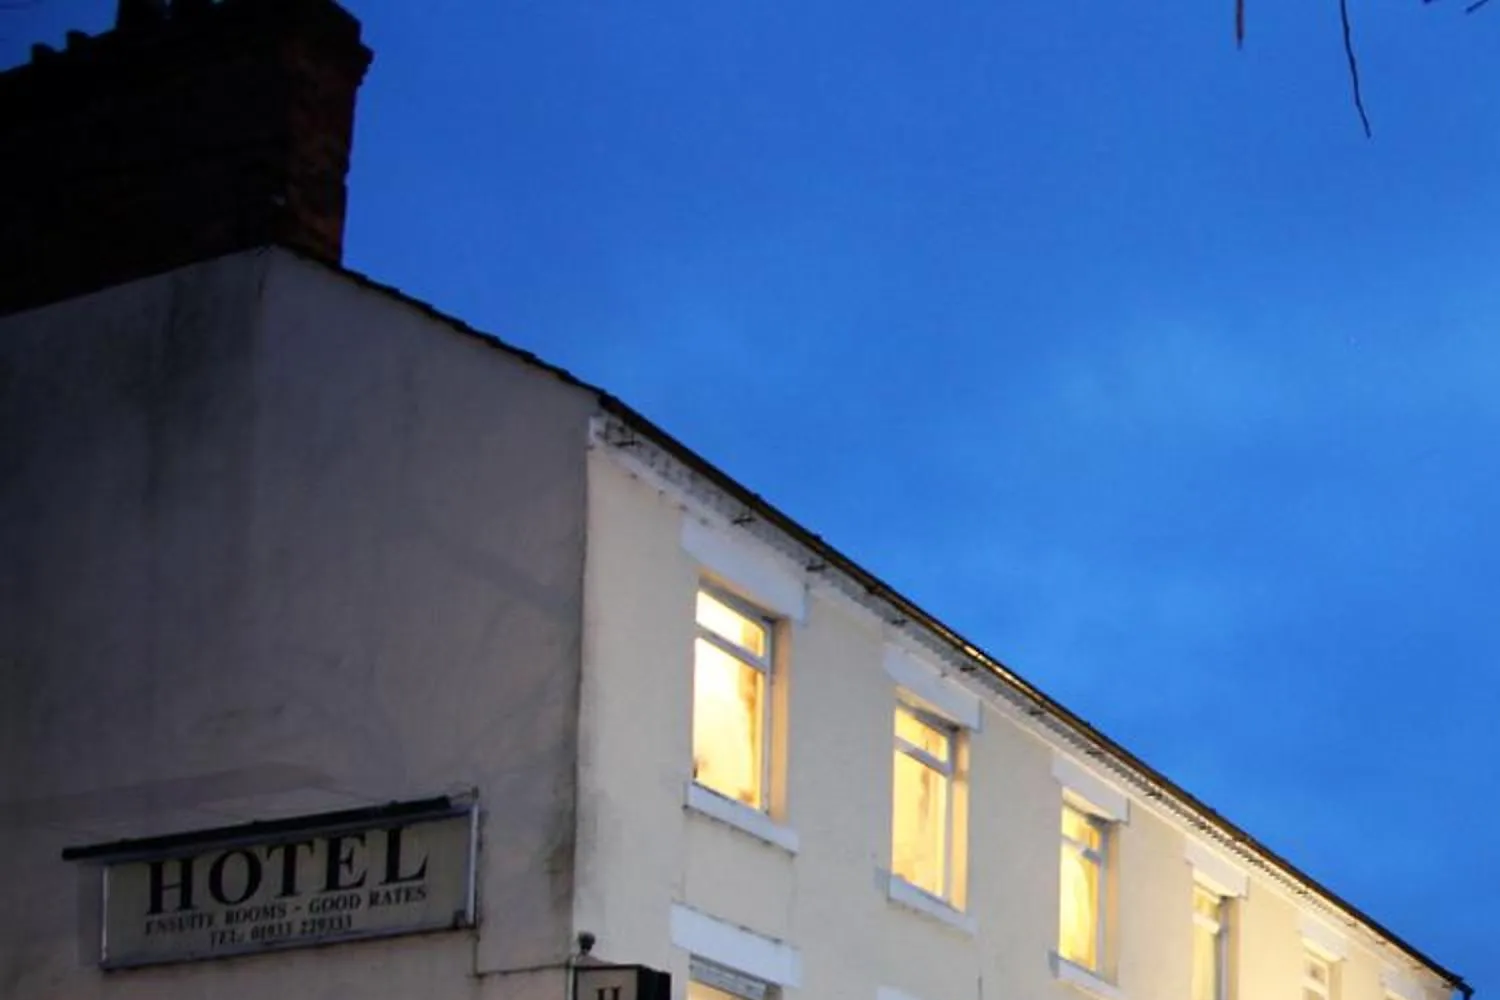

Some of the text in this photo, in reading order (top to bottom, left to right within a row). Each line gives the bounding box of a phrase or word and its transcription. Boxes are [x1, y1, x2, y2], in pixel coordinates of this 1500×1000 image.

[145, 828, 428, 916] HOTEL
[225, 902, 287, 925] ROOMS
[308, 893, 362, 914] GOOD
[369, 885, 428, 908] RATES
